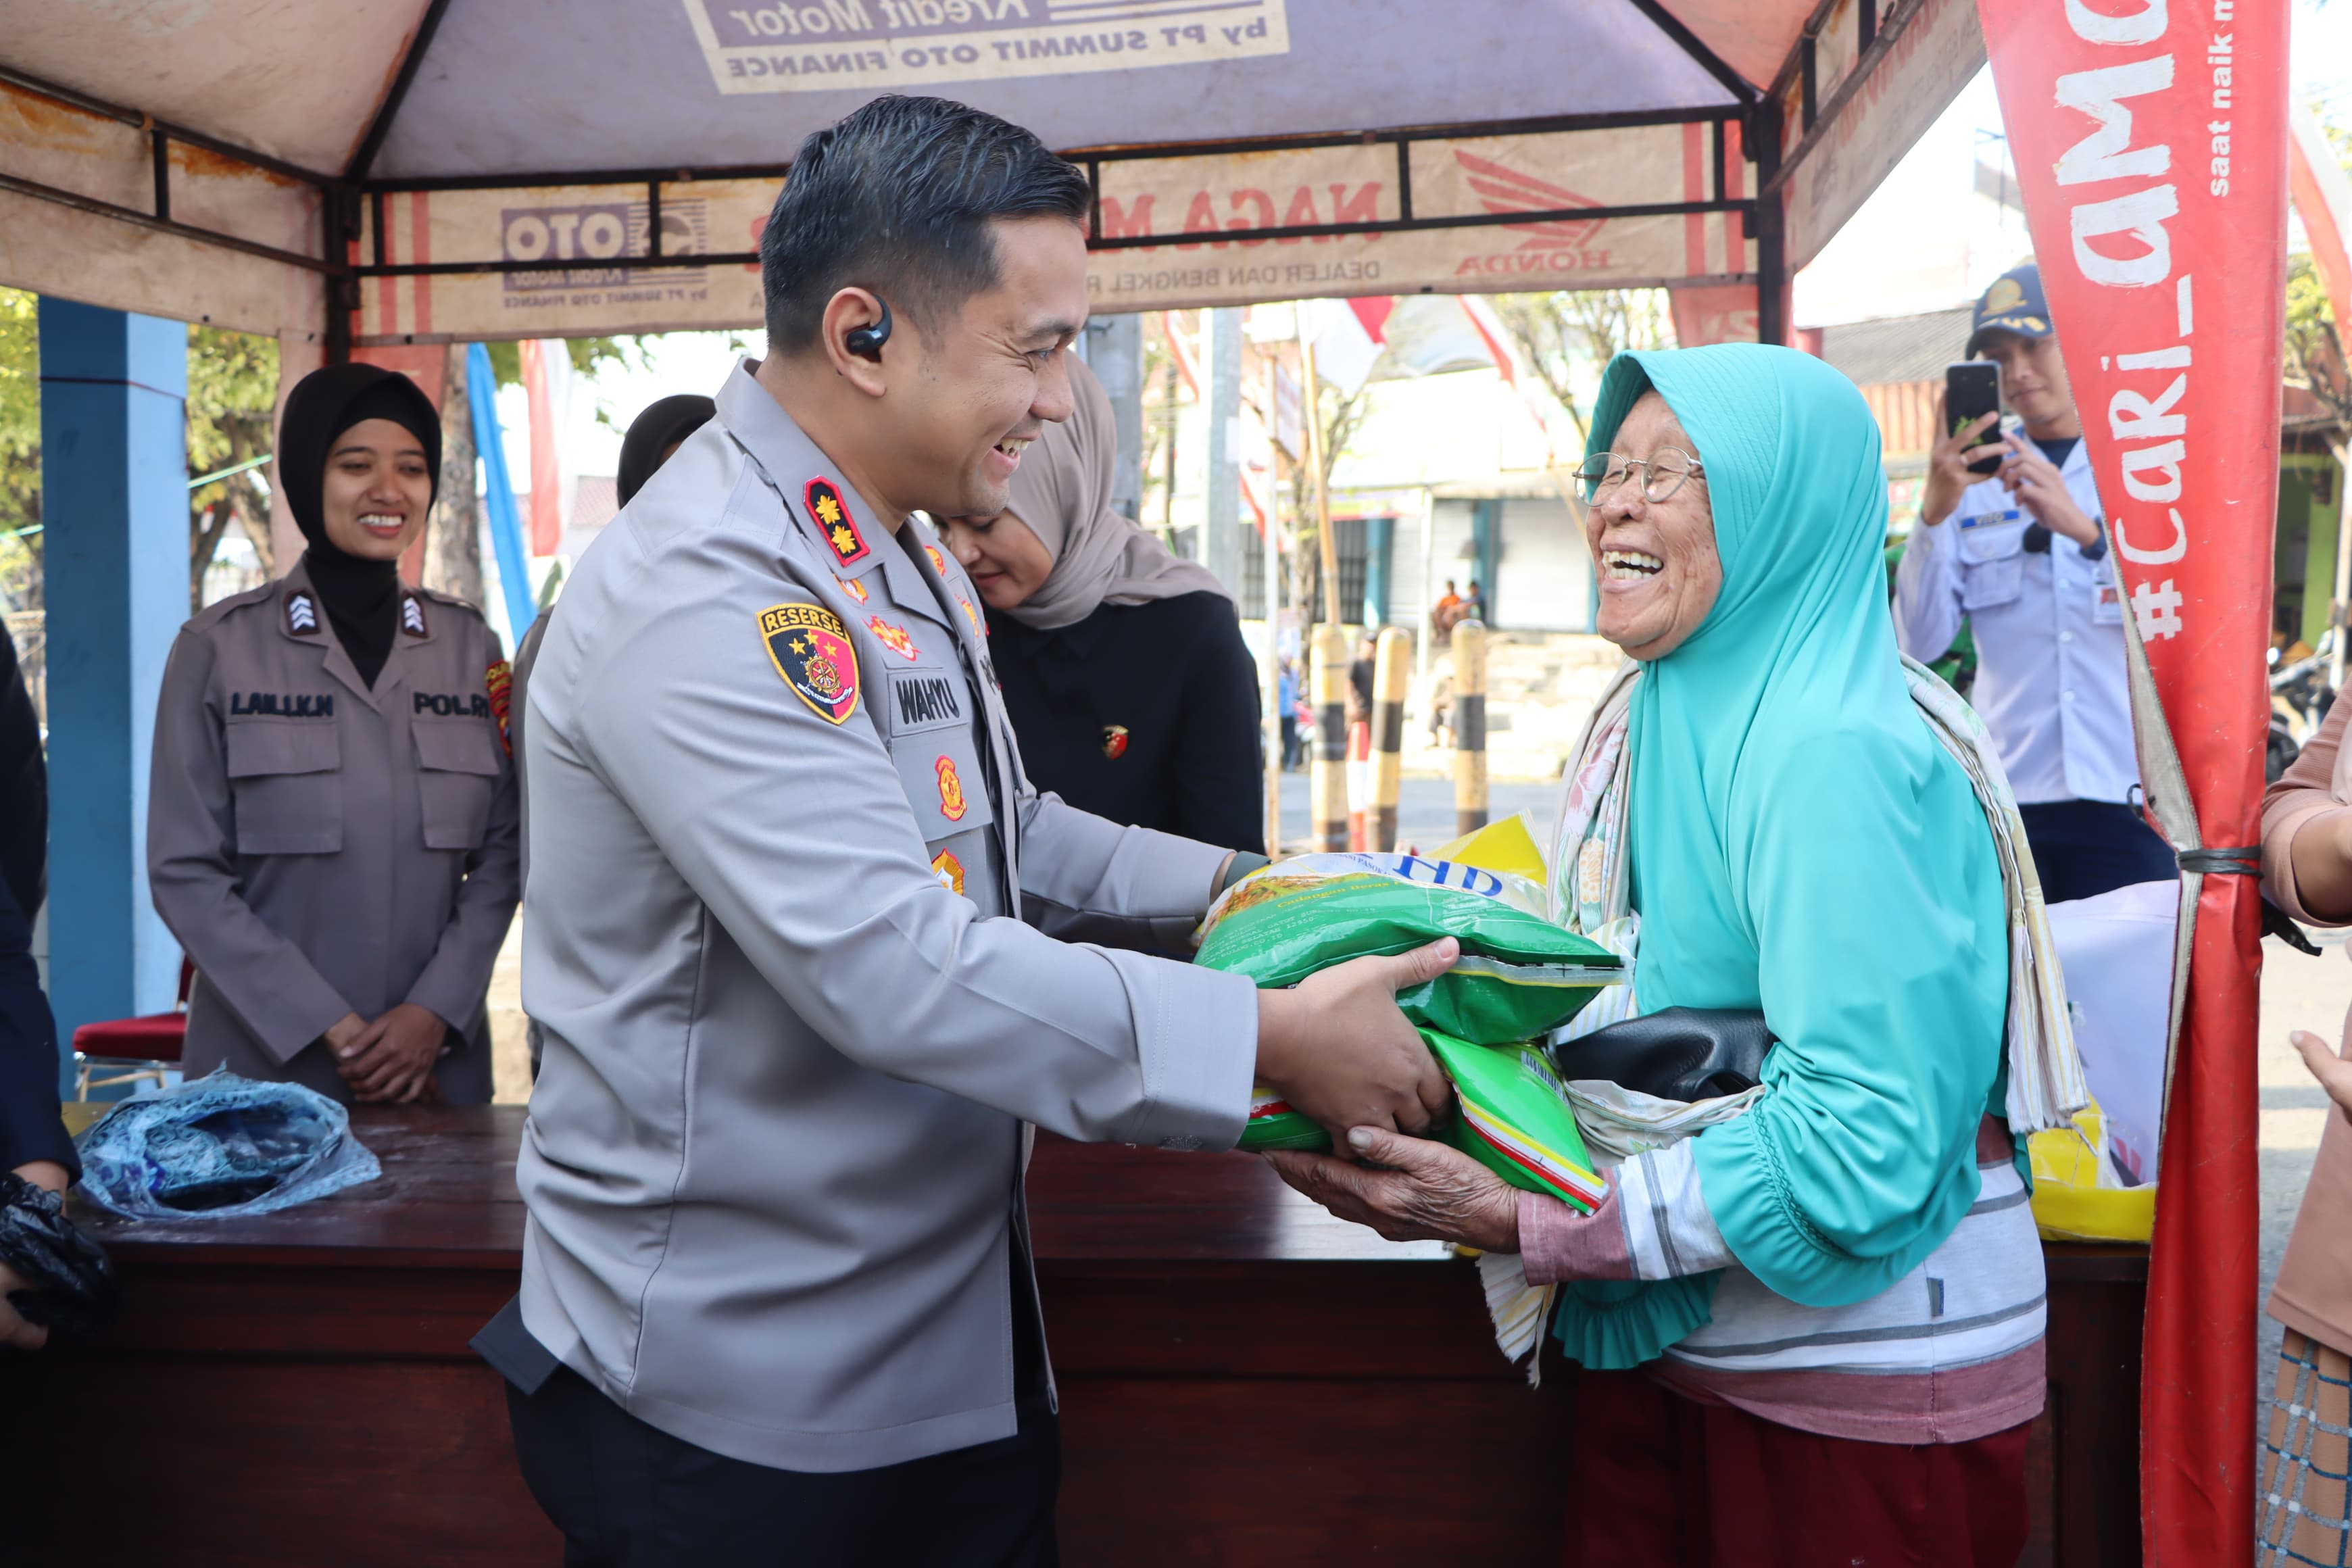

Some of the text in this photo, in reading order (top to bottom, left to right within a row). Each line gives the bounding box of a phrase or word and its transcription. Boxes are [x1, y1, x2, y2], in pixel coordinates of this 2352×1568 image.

[2207, 34, 2233, 109] naik
[2207, 121, 2232, 197] saat
[764, 608, 845, 637] RESERSE
[414, 691, 489, 719] POLRI
[896, 677, 960, 725] WAHYU
